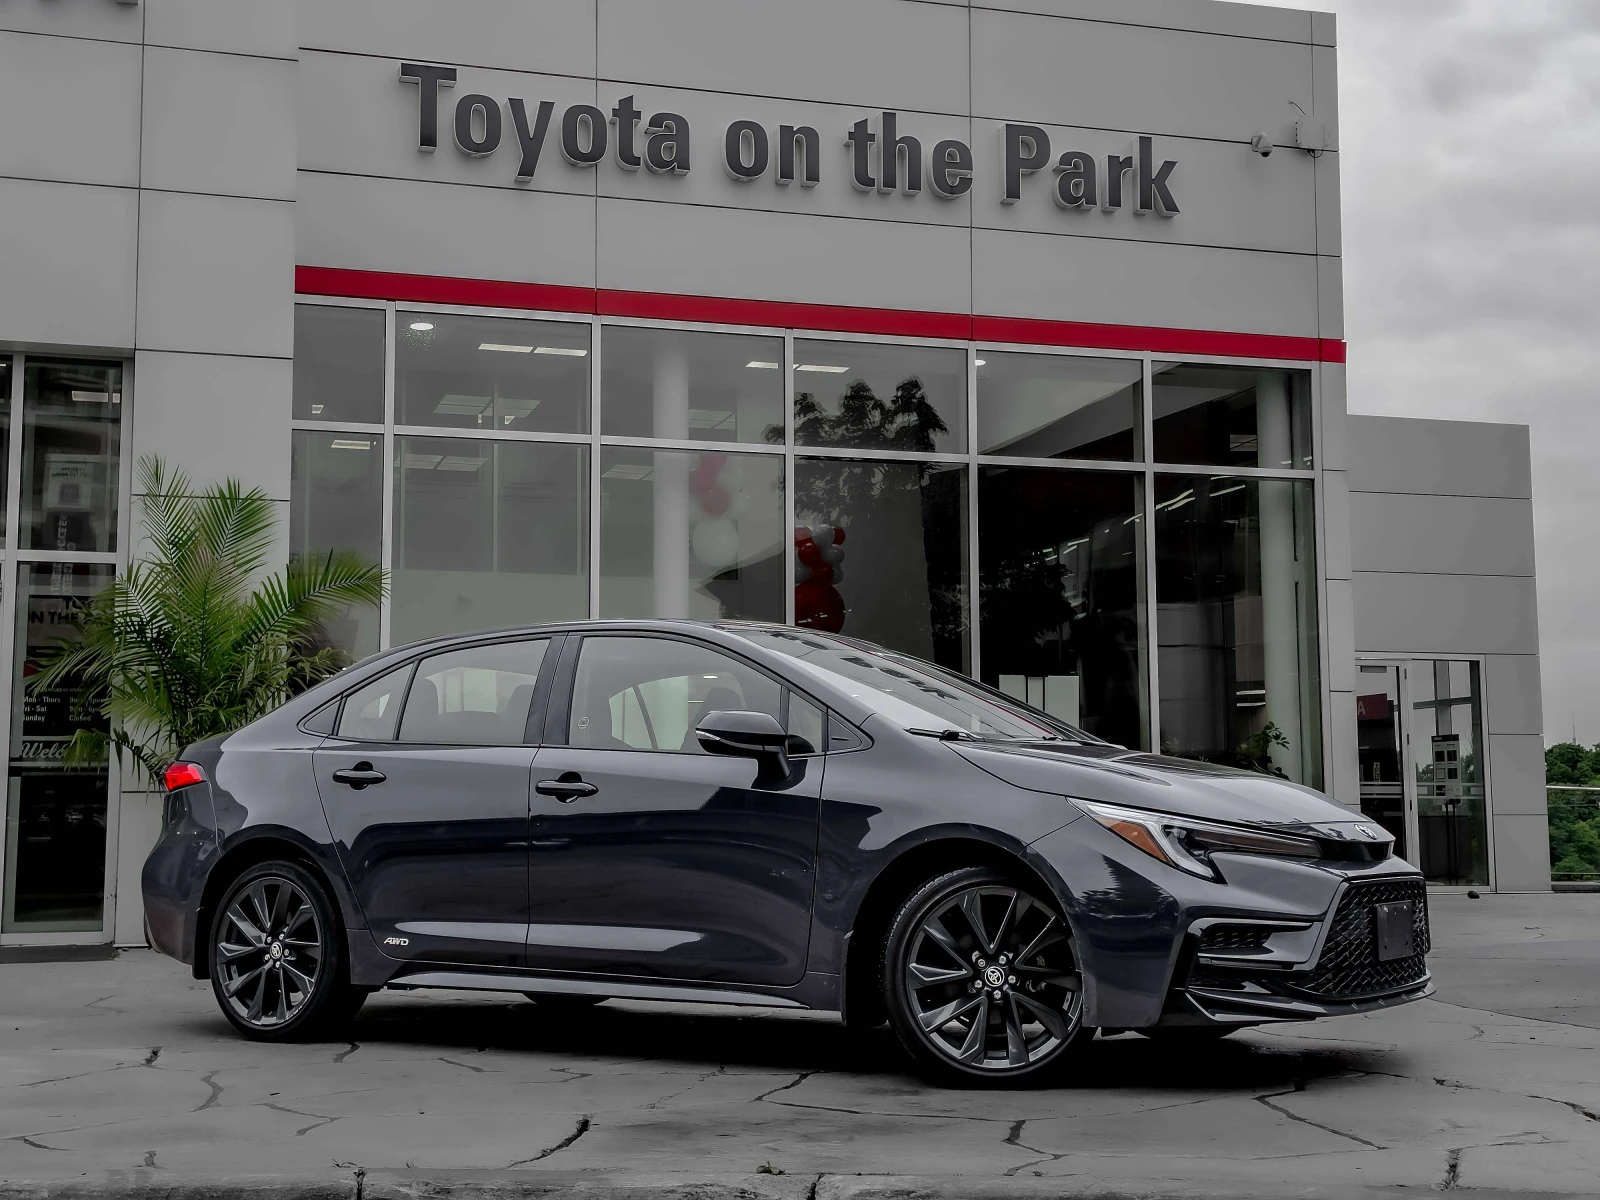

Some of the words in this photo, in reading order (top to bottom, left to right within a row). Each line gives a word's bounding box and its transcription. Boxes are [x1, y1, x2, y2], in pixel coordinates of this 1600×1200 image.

[399, 63, 691, 183] Toyota
[722, 119, 820, 186] on
[843, 111, 974, 200] the
[1000, 122, 1181, 218] Park
[48, 611, 78, 624] THE
[383, 937, 409, 946] AWD
